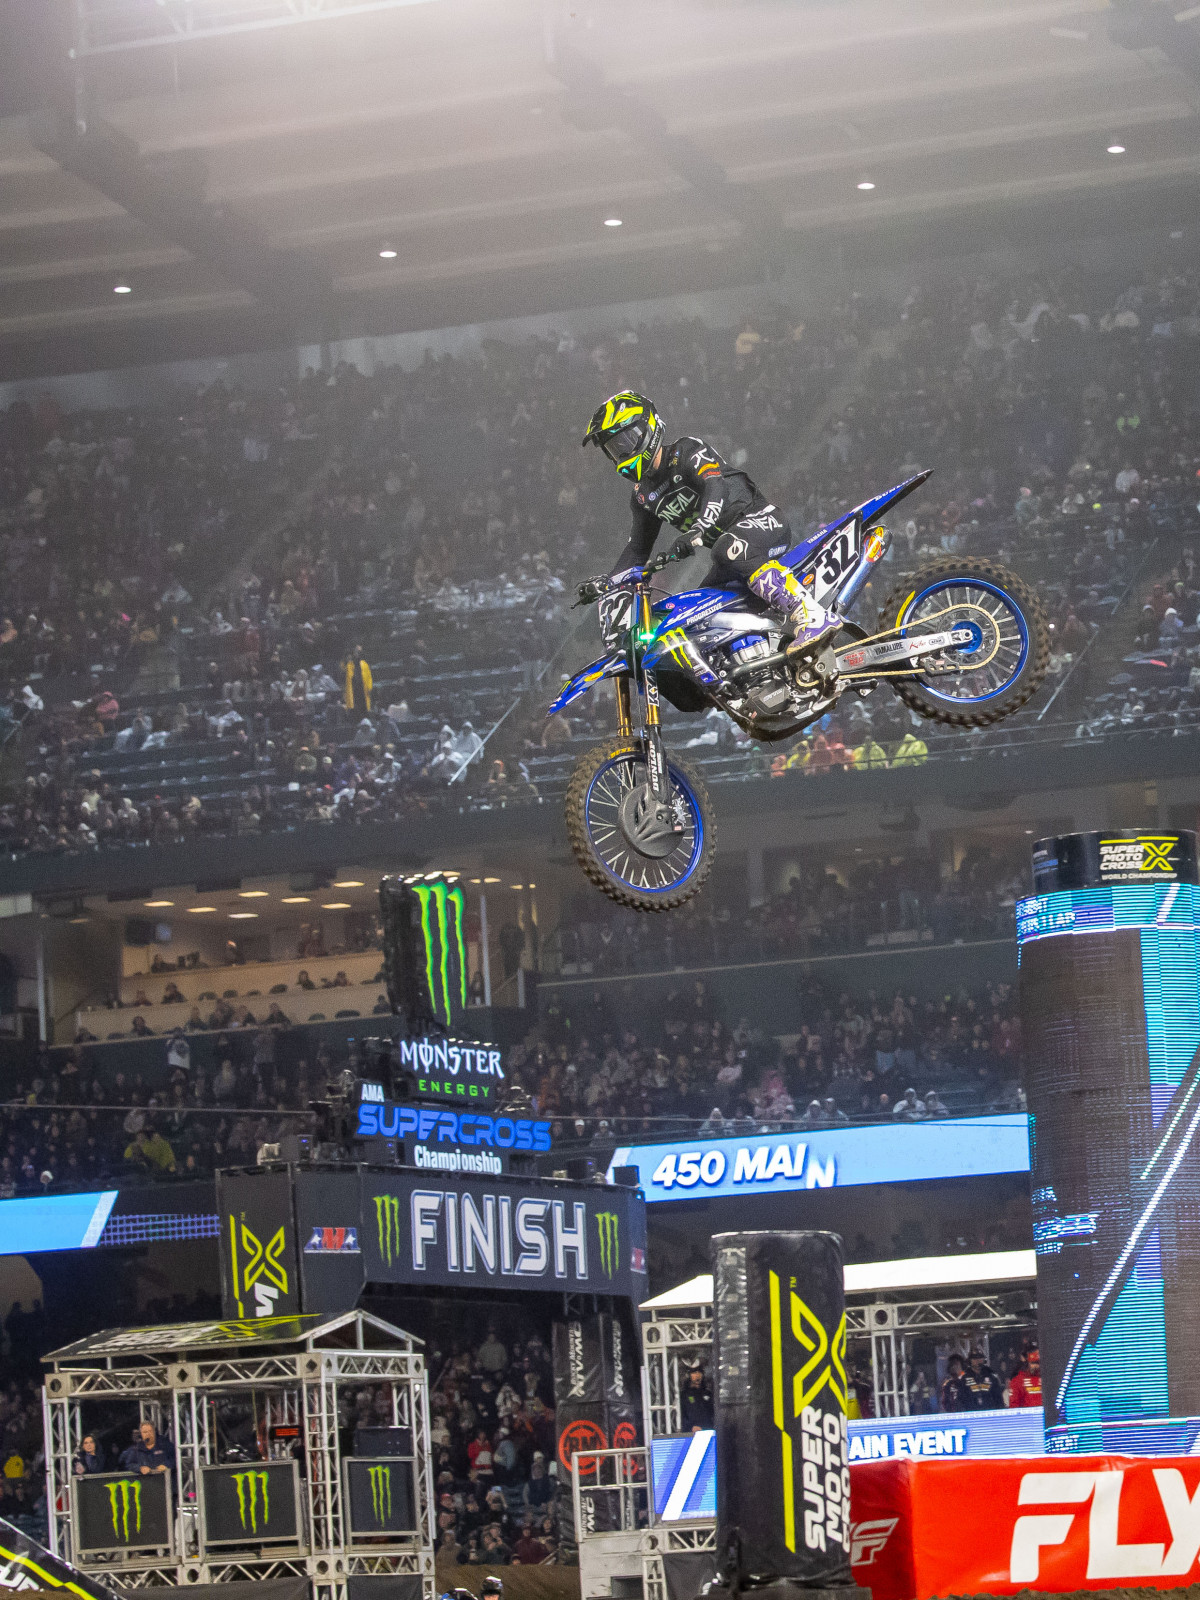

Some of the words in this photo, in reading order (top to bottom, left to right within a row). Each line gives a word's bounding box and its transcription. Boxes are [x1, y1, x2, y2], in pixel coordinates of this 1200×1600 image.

[806, 528, 829, 545] YAMAHA
[821, 533, 860, 585] 32
[686, 601, 724, 626] PROGRESSIVE
[874, 642, 904, 655] YAMALUBE
[649, 740, 660, 792] DUNLOP
[1100, 844, 1144, 855] SUPER
[1103, 853, 1142, 862] MOTO
[1100, 861, 1143, 871] CROSS
[1101, 873, 1128, 881] WORLD
[1128, 872, 1177, 880] CHAMPIONSHIP
[401, 1037, 505, 1078] MONSTER
[361, 1083, 385, 1103] AMA
[418, 1079, 490, 1098] ENERGY
[357, 1103, 552, 1152] SUPERCROSS
[414, 1145, 502, 1175] Championship
[652, 1150, 726, 1188] 450
[732, 1142, 836, 1189] MAIN
[303, 1226, 361, 1254] AMA
[411, 1189, 589, 1279] FINISH
[849, 1435, 888, 1459] AIN
[893, 1429, 967, 1455] EVENT
[801, 1405, 826, 1552] SUPER
[823, 1412, 843, 1544] MOTO
